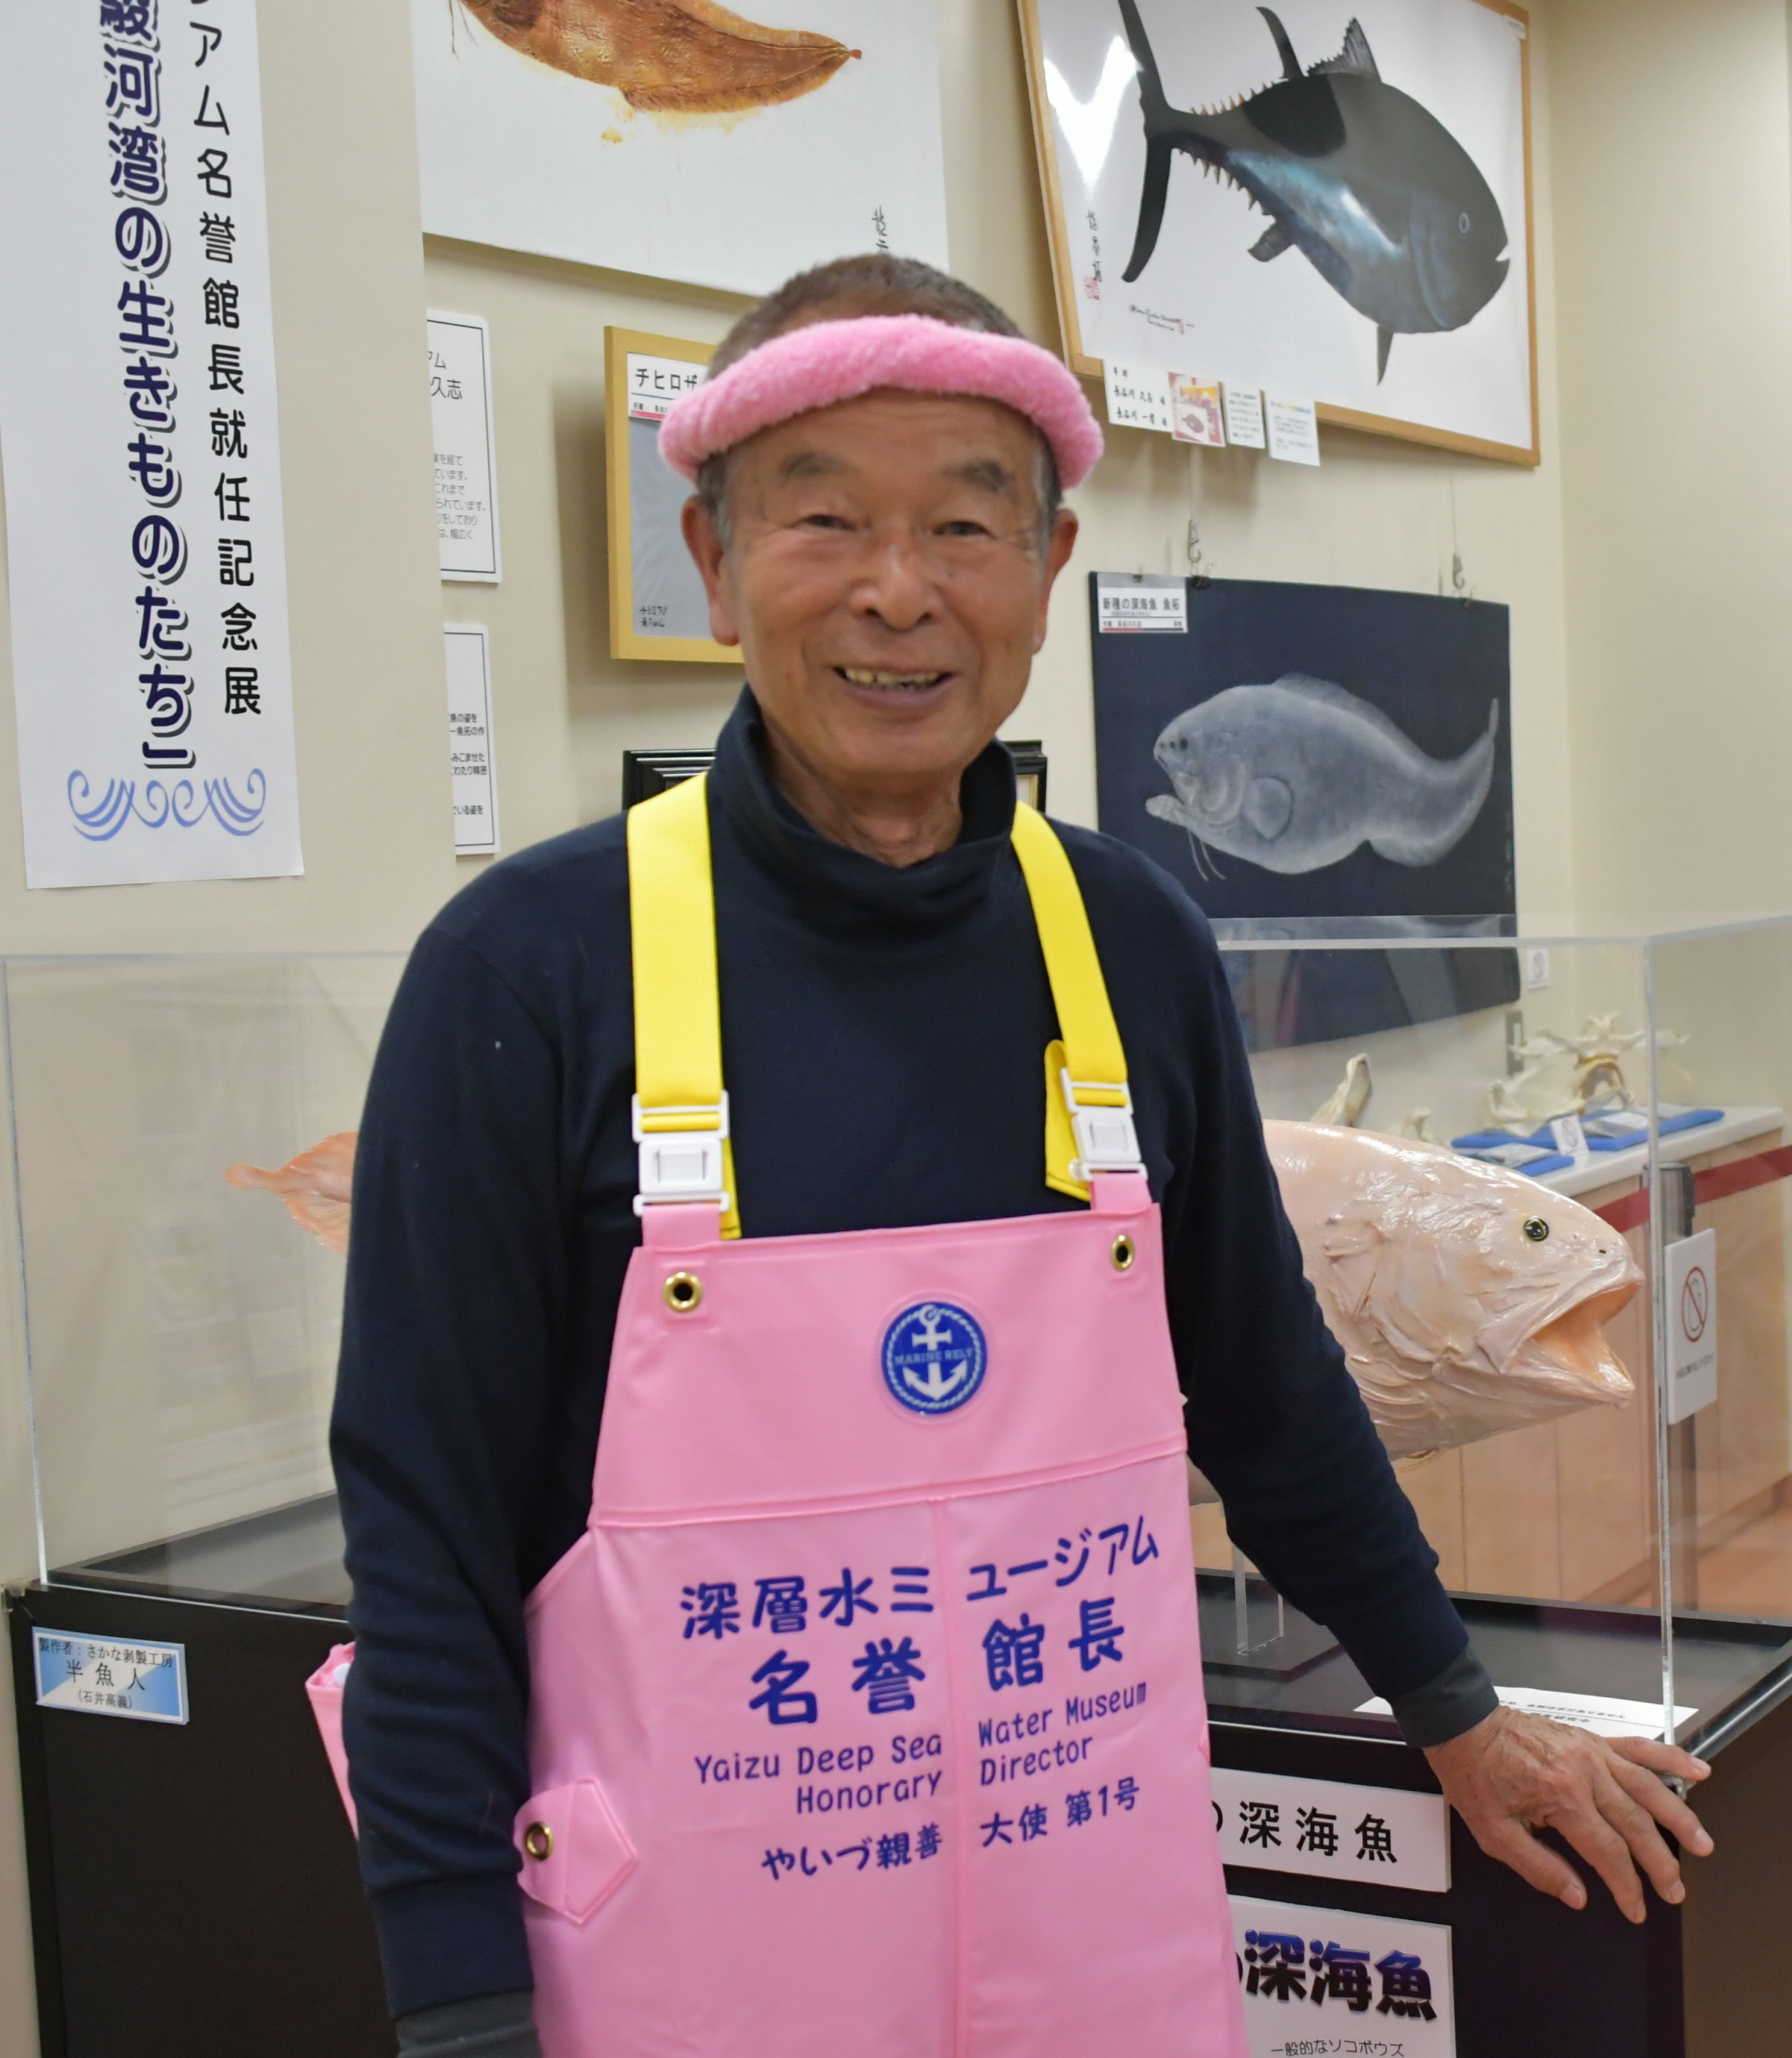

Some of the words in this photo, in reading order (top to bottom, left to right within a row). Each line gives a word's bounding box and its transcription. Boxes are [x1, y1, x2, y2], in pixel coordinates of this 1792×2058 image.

[190, 0, 261, 715] アム名誉館長就任記念展
[430, 377, 462, 400] 久志
[66, 1658, 146, 1691] 半魚人
[749, 1637, 926, 1725] 名誉
[982, 1597, 1125, 1692] 館長
[694, 1752, 780, 1784] Yaizu
[797, 1745, 874, 1775] Deep
[892, 1734, 942, 1764] Sea
[978, 1707, 1053, 1748] Water
[1065, 1681, 1147, 1726] Museum
[796, 1770, 943, 1815] Honorary
[980, 1736, 1093, 1787] Director
[761, 1822, 942, 1879] やいづ親善
[979, 1803, 1047, 1848] 大使
[1064, 1776, 1140, 1826] 第1号
[1236, 1928, 1438, 2022] 深海魚
